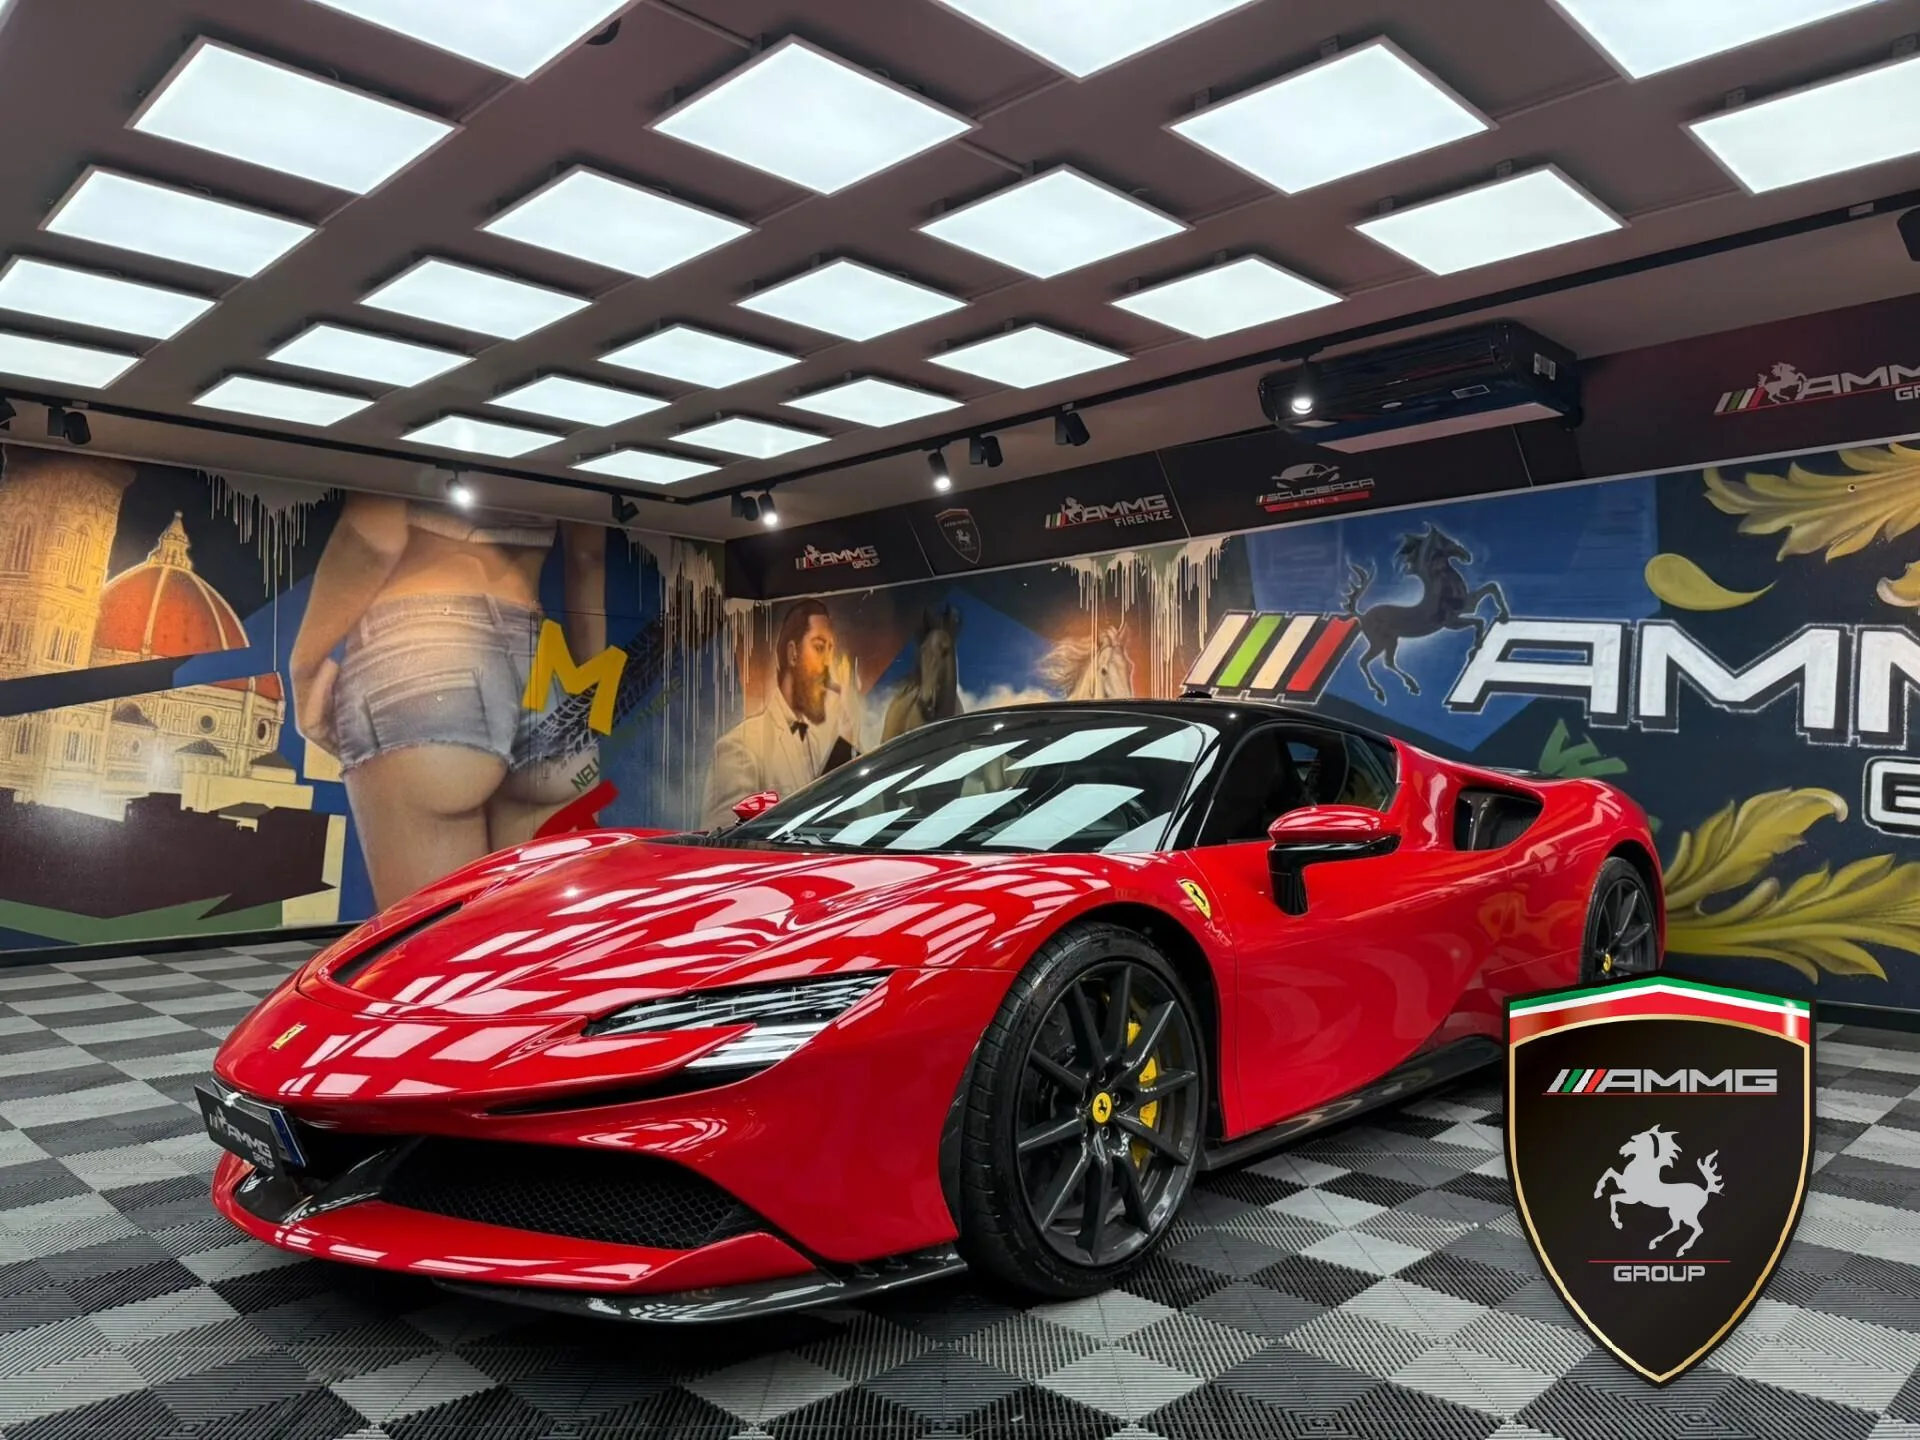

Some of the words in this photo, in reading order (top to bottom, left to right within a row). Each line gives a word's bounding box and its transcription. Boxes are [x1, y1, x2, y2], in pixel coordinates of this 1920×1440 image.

[1265, 478, 1376, 502] SCUDERIA
[1082, 494, 1169, 521] AMMG
[1114, 509, 1173, 527] FIRENZE
[820, 545, 878, 565] AMMG
[227, 1122, 274, 1160] AMMG
